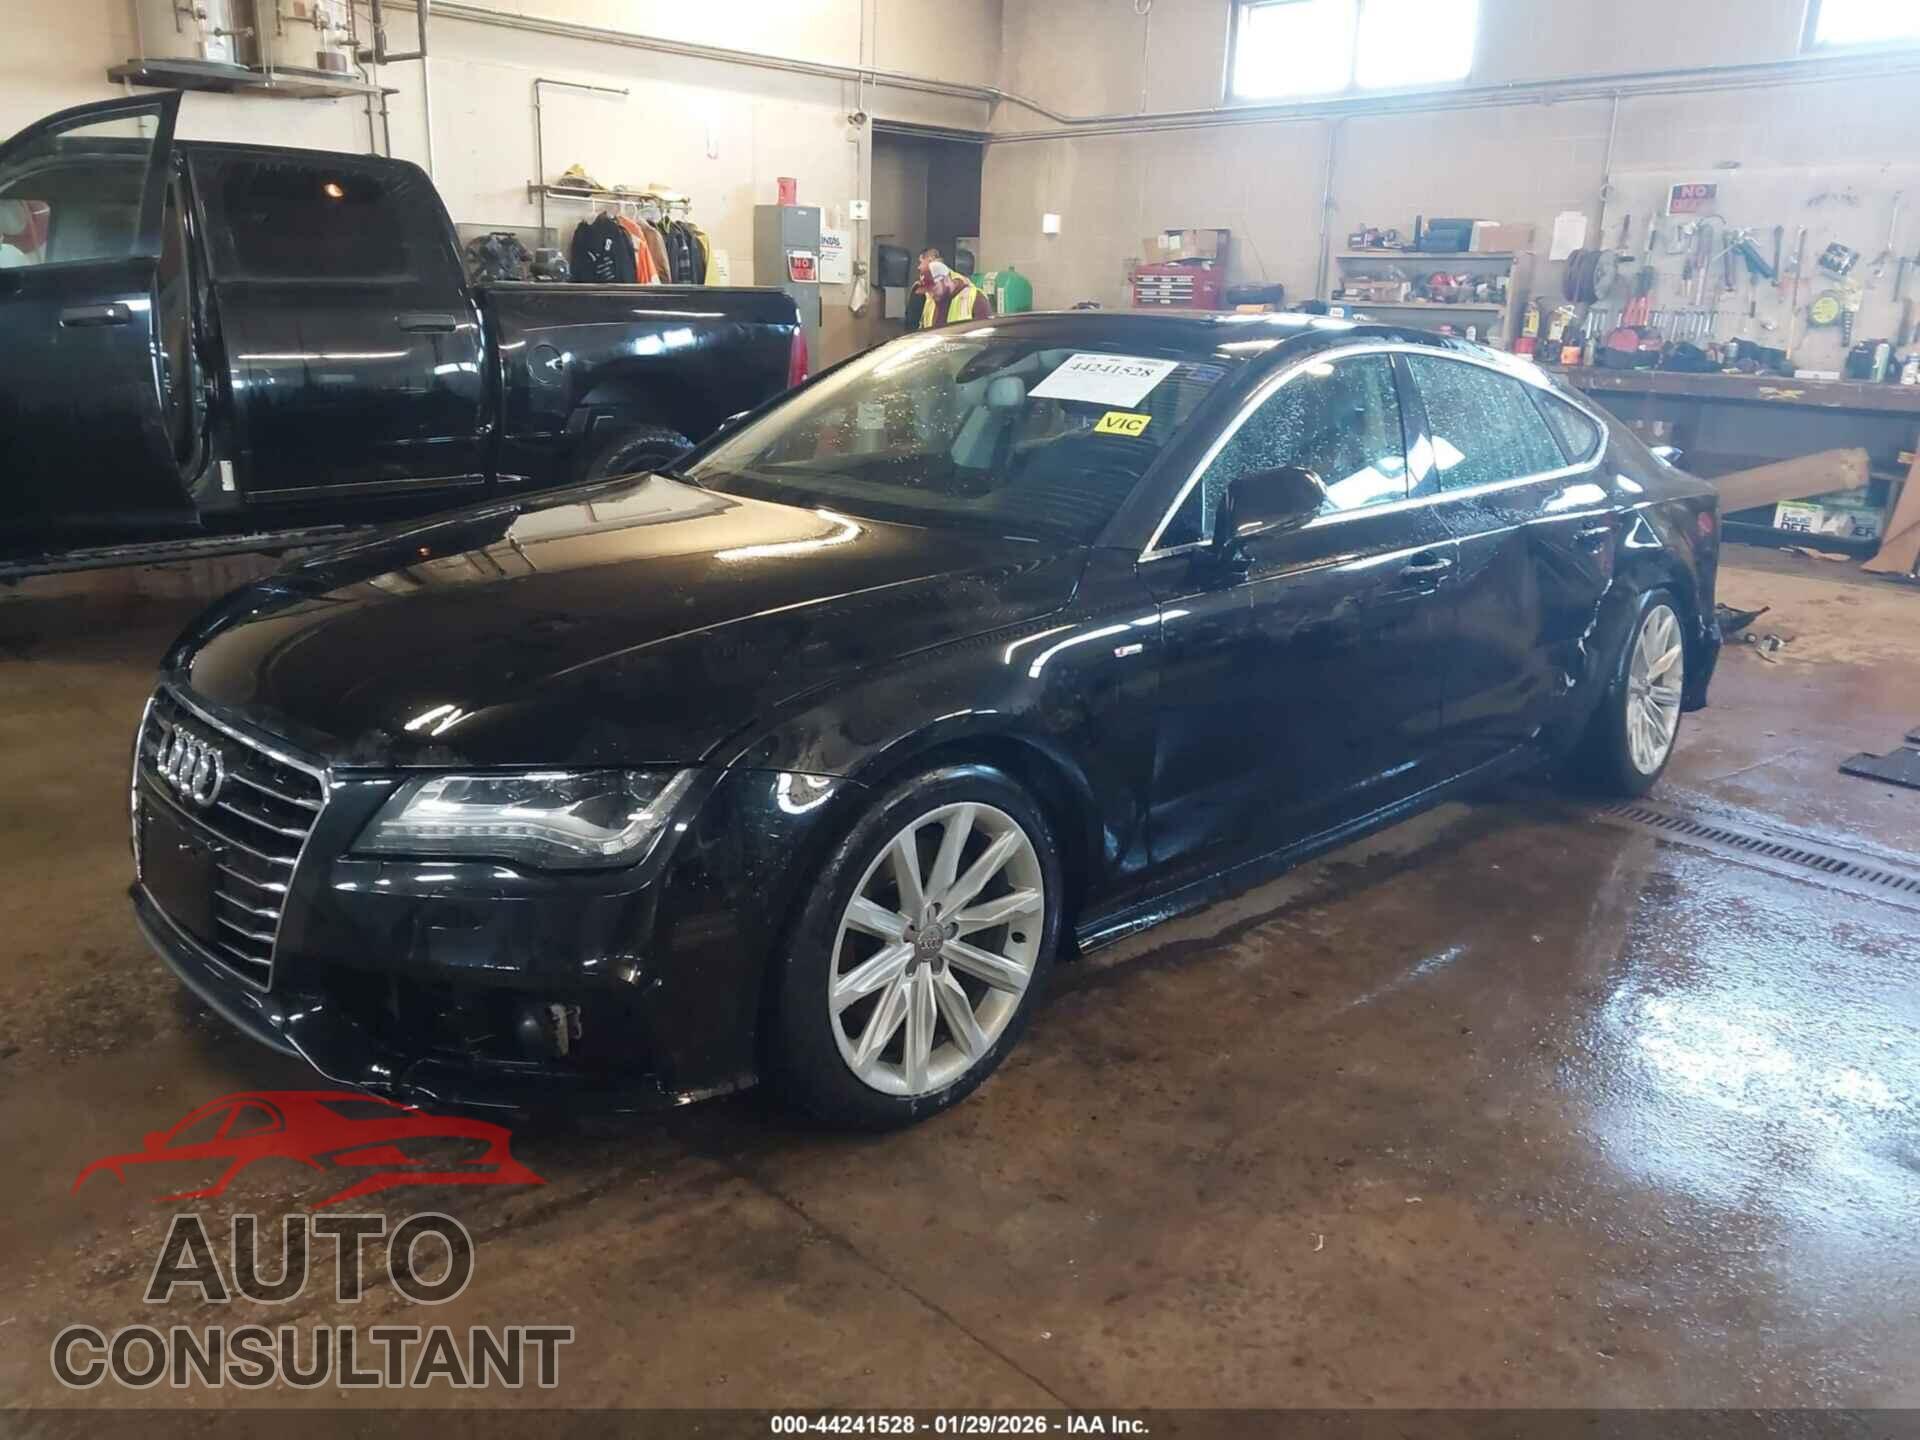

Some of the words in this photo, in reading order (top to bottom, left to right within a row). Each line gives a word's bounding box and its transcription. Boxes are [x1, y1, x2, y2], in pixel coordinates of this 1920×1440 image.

[1681, 185, 1706, 198] NO
[1070, 362, 1154, 377] 44241528
[1106, 417, 1143, 431] VIC
